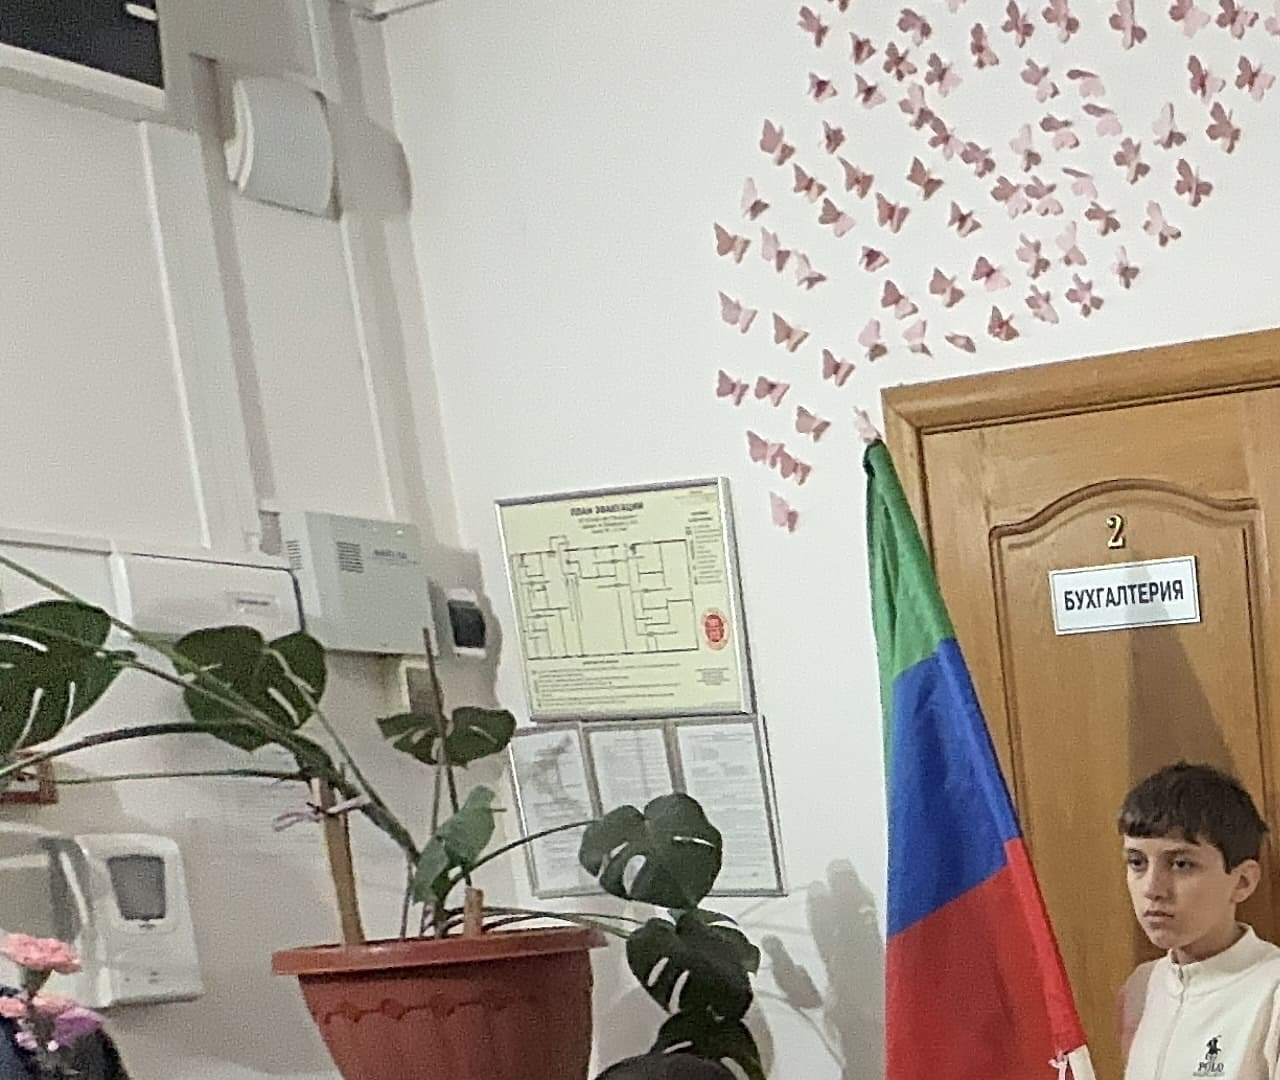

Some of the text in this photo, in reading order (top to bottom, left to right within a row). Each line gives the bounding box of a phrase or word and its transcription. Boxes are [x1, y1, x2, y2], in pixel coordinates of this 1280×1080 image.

[1105, 513, 1125, 549] 2
[1064, 579, 1184, 611] БУХГАЛТЕРИЯ
[1197, 1061, 1225, 1073] POLO
